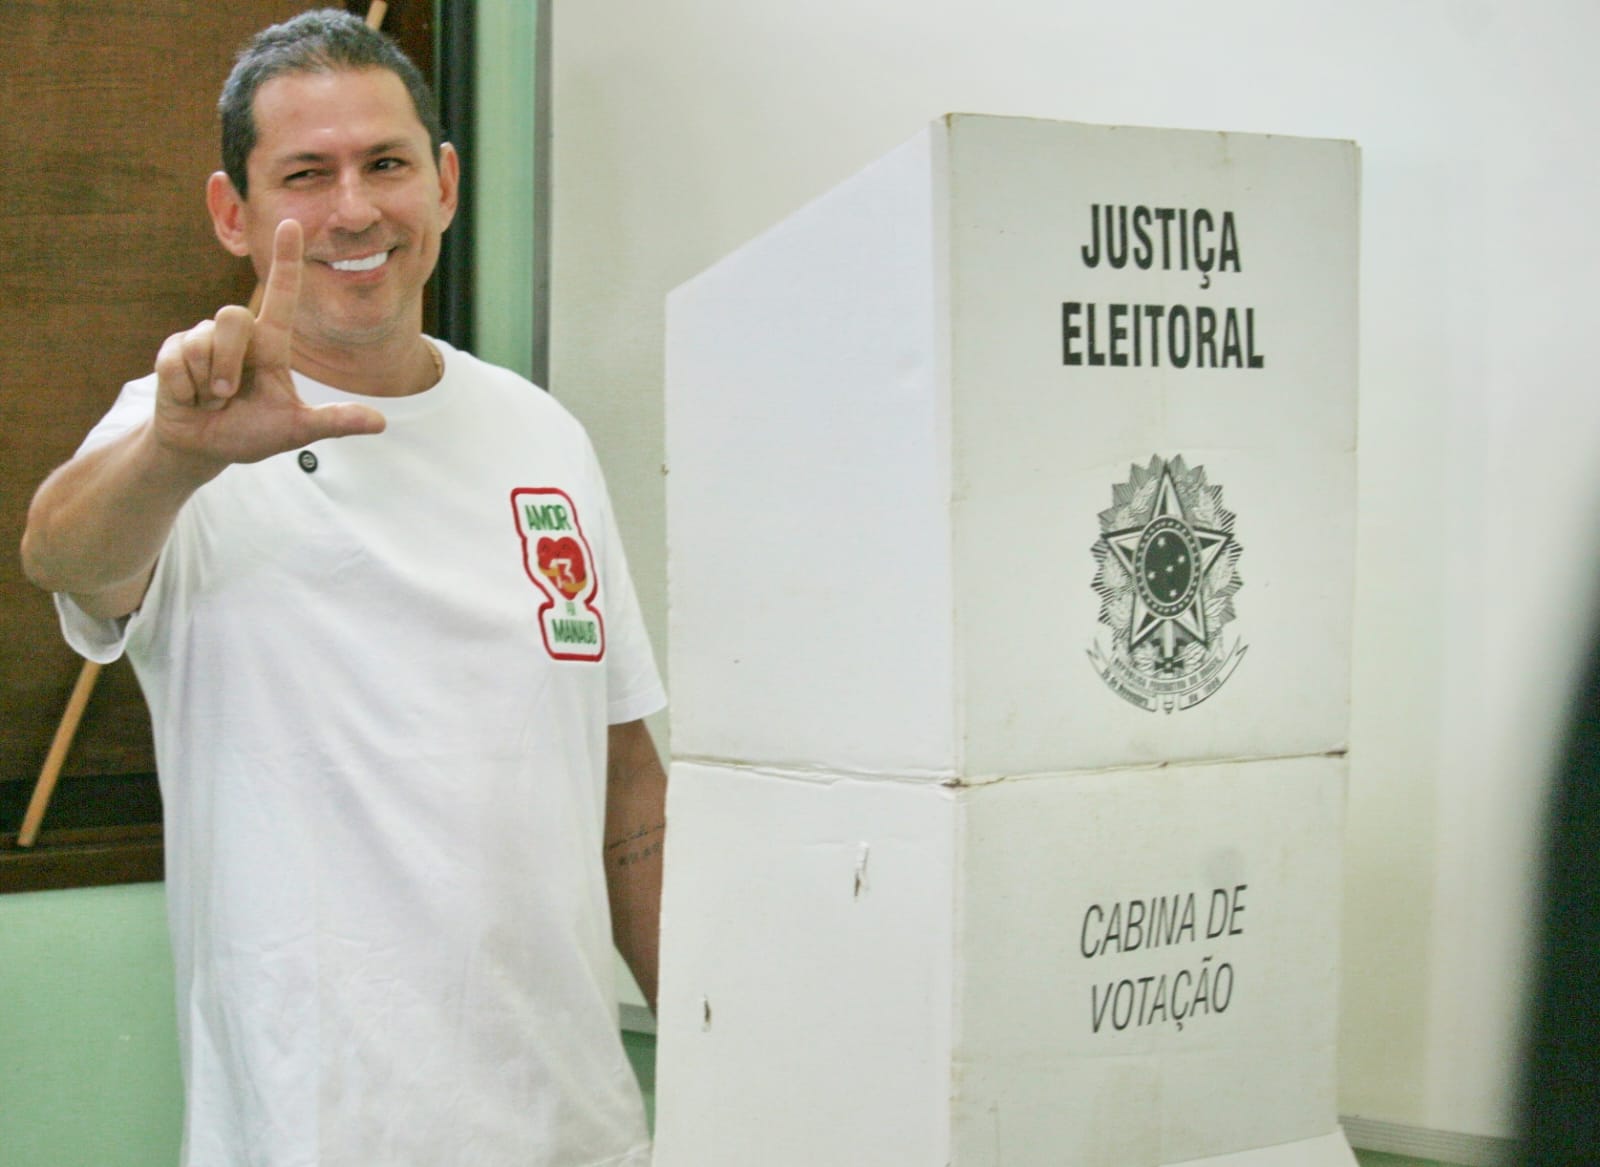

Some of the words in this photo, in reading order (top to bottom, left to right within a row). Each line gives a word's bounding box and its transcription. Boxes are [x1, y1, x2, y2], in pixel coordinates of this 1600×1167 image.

[1081, 204, 1241, 290] JUSTIÇA
[1062, 302, 1264, 369] ELEITORAL
[525, 505, 572, 531] AMOR
[1080, 892, 1196, 959] CABINA
[1206, 884, 1248, 939] DE
[1091, 956, 1234, 1034] VOTAÇÃO
